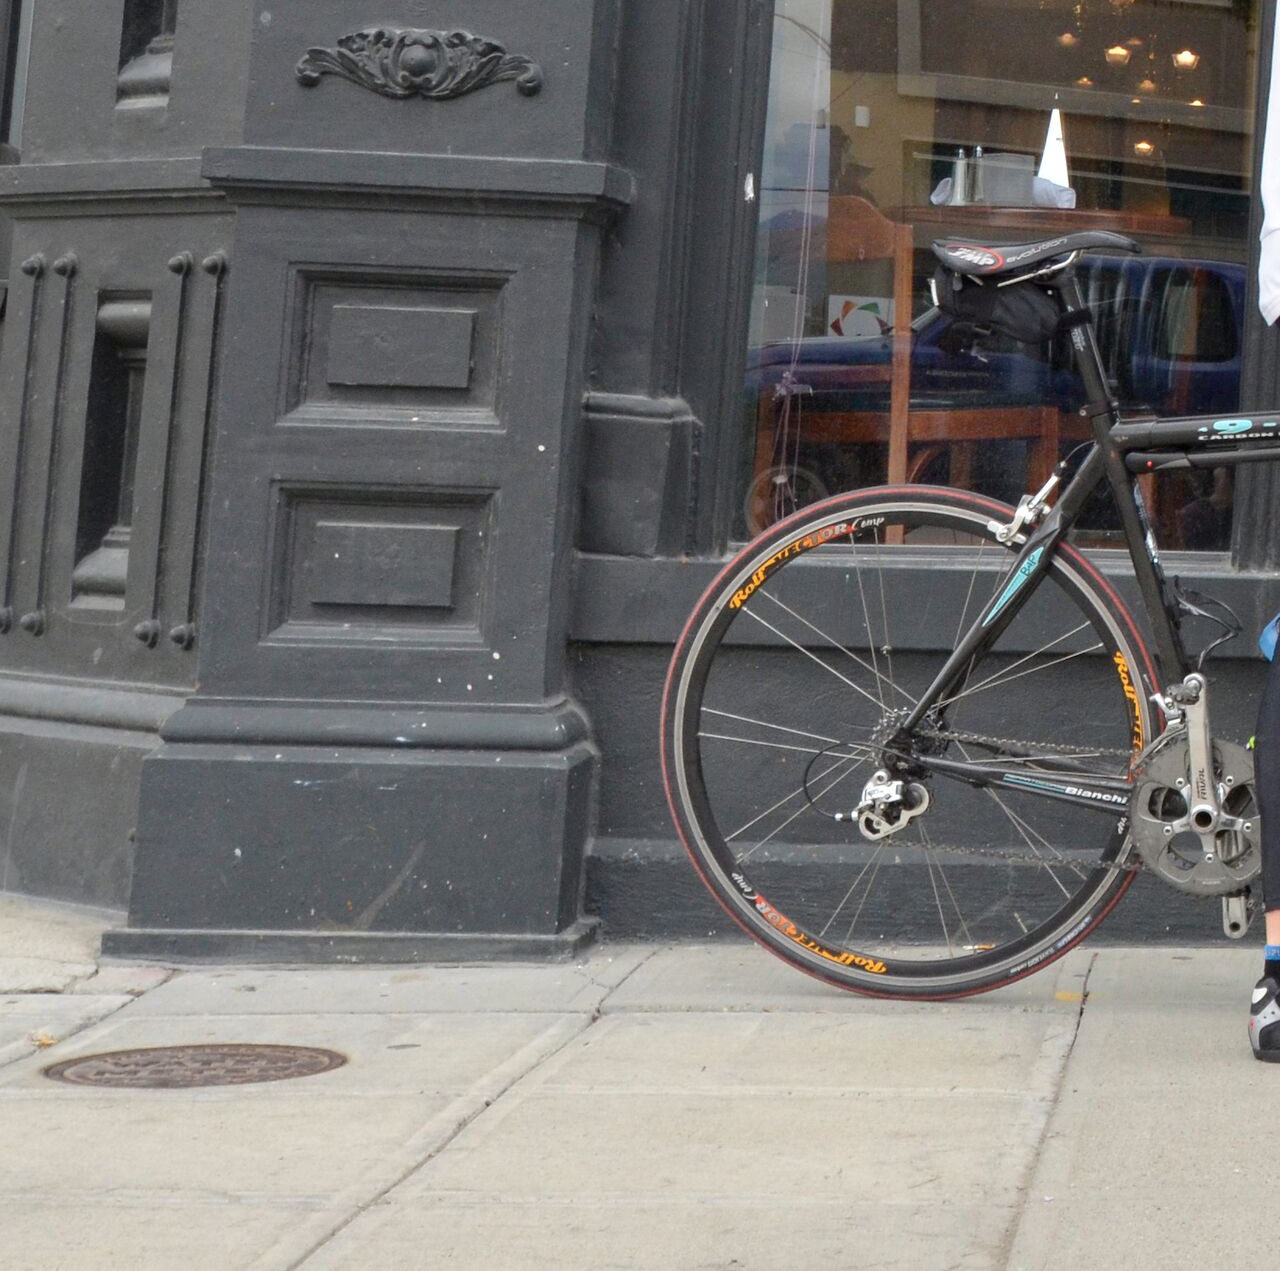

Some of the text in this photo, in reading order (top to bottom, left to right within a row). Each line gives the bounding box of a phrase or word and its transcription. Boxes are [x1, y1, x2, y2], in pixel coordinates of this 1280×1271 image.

[1006, 238, 1068, 263] evolution
[1198, 431, 1274, 441] CARBON
[852, 516, 885, 538] Comp
[1064, 786, 1128, 805] Bianchi
